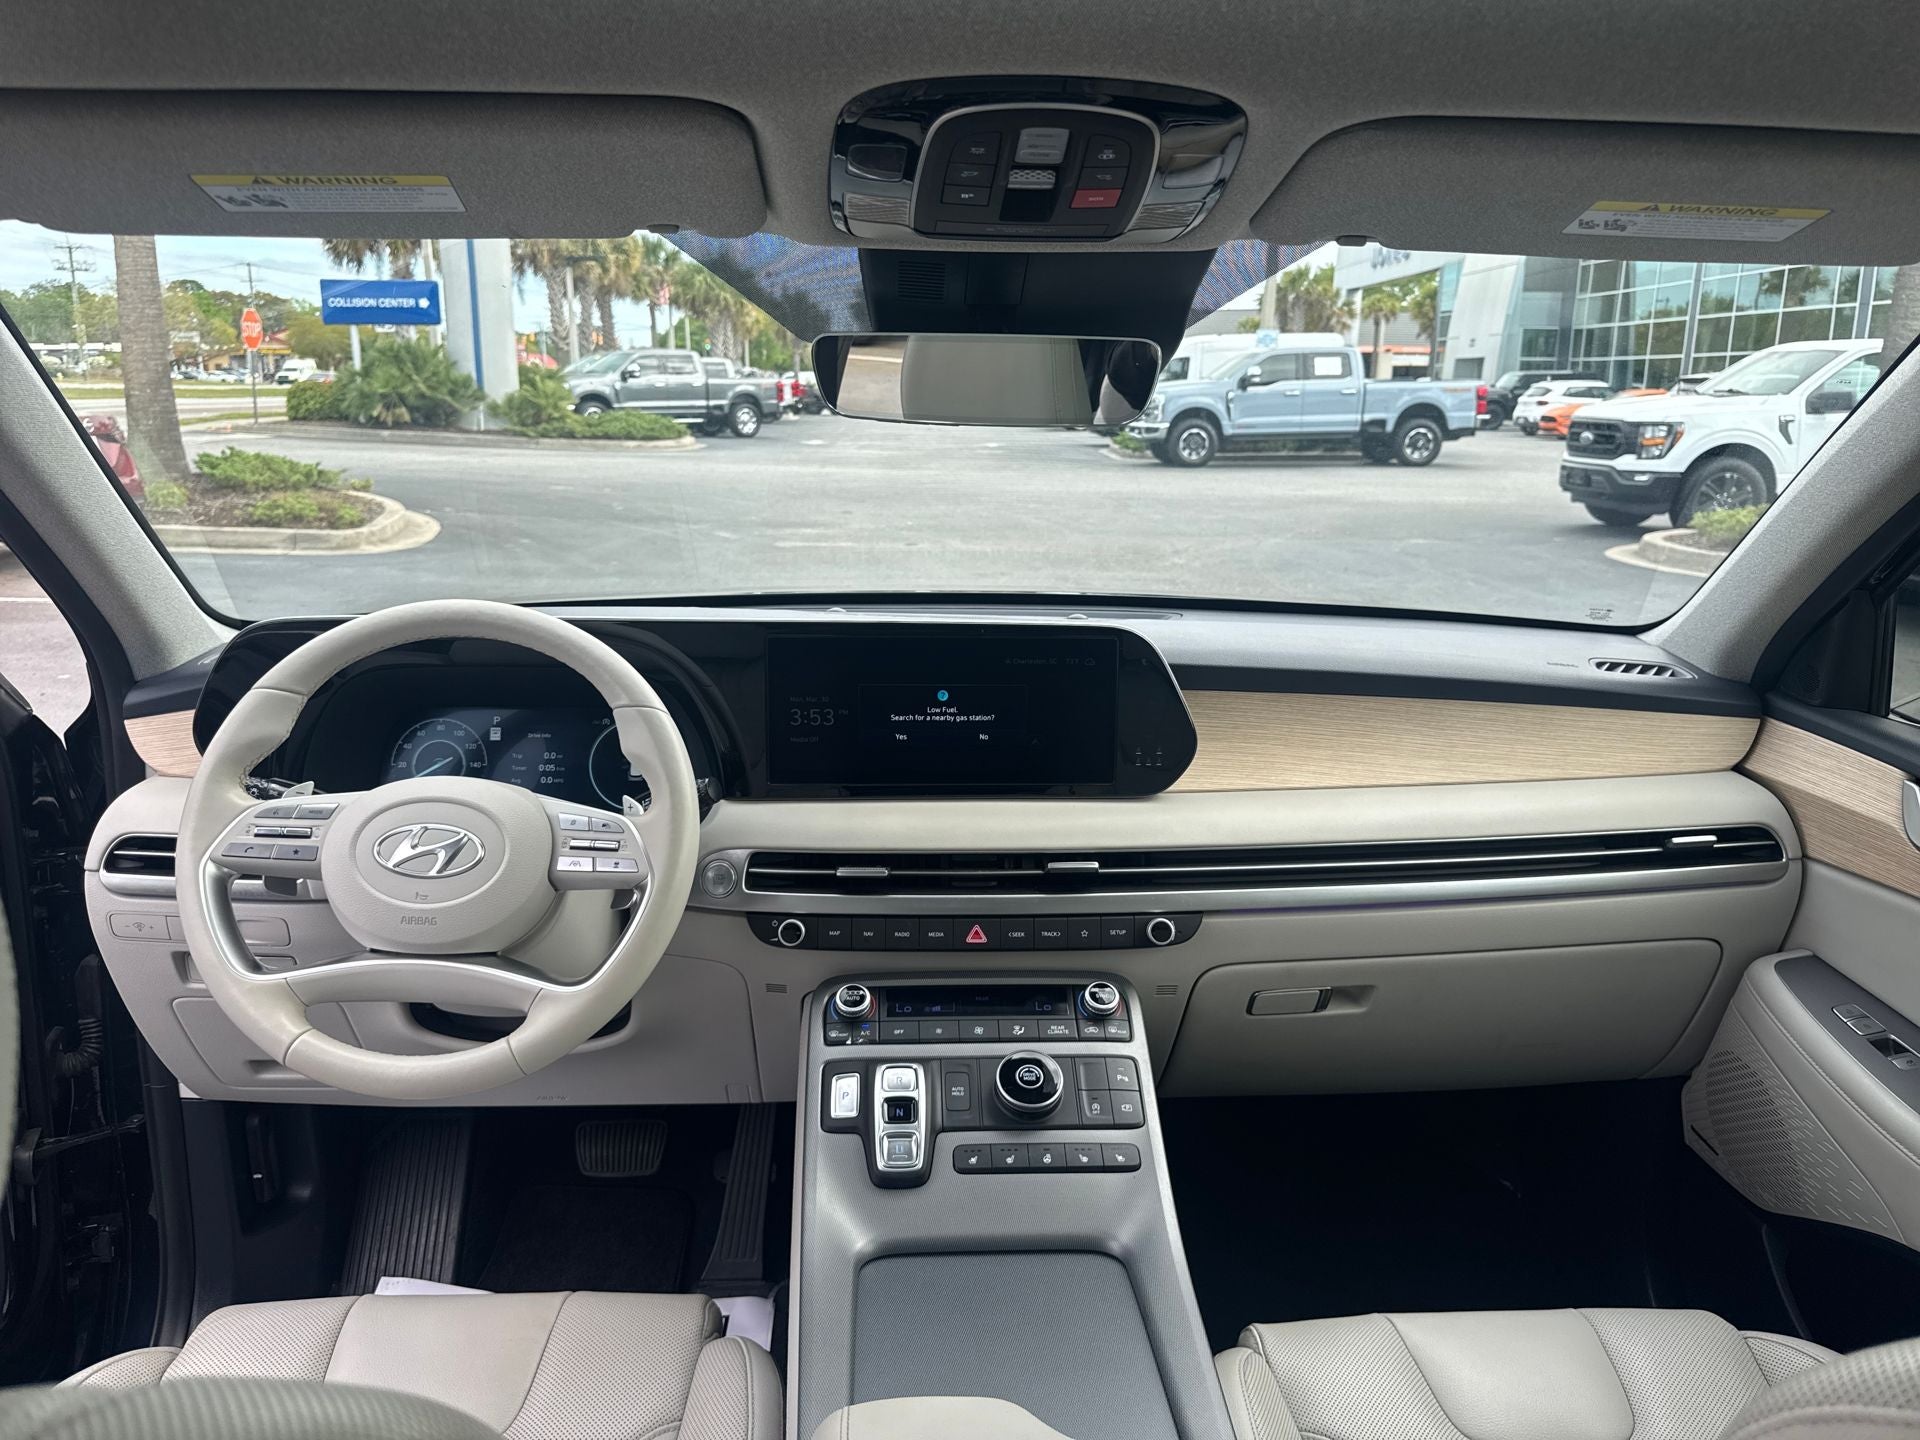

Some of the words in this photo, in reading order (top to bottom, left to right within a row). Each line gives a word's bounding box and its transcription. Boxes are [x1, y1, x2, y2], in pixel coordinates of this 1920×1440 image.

[277, 176, 398, 186] WARNING
[1669, 204, 1779, 217] WARNING
[328, 298, 377, 308] COLLISION
[378, 298, 416, 308] CENTER
[241, 322, 262, 337] STOP
[493, 716, 501, 725] P
[790, 708, 835, 726] 3:53
[931, 714, 954, 723] nearby
[955, 715, 968, 723] gas
[540, 776, 553, 784] 0.0
[400, 915, 439, 926] AIRBAG
[895, 1003, 912, 1013] Lo
[1035, 1001, 1052, 1011] Lo
[896, 1076, 903, 1085] R
[842, 1091, 849, 1100] P
[896, 1107, 904, 1117] N
